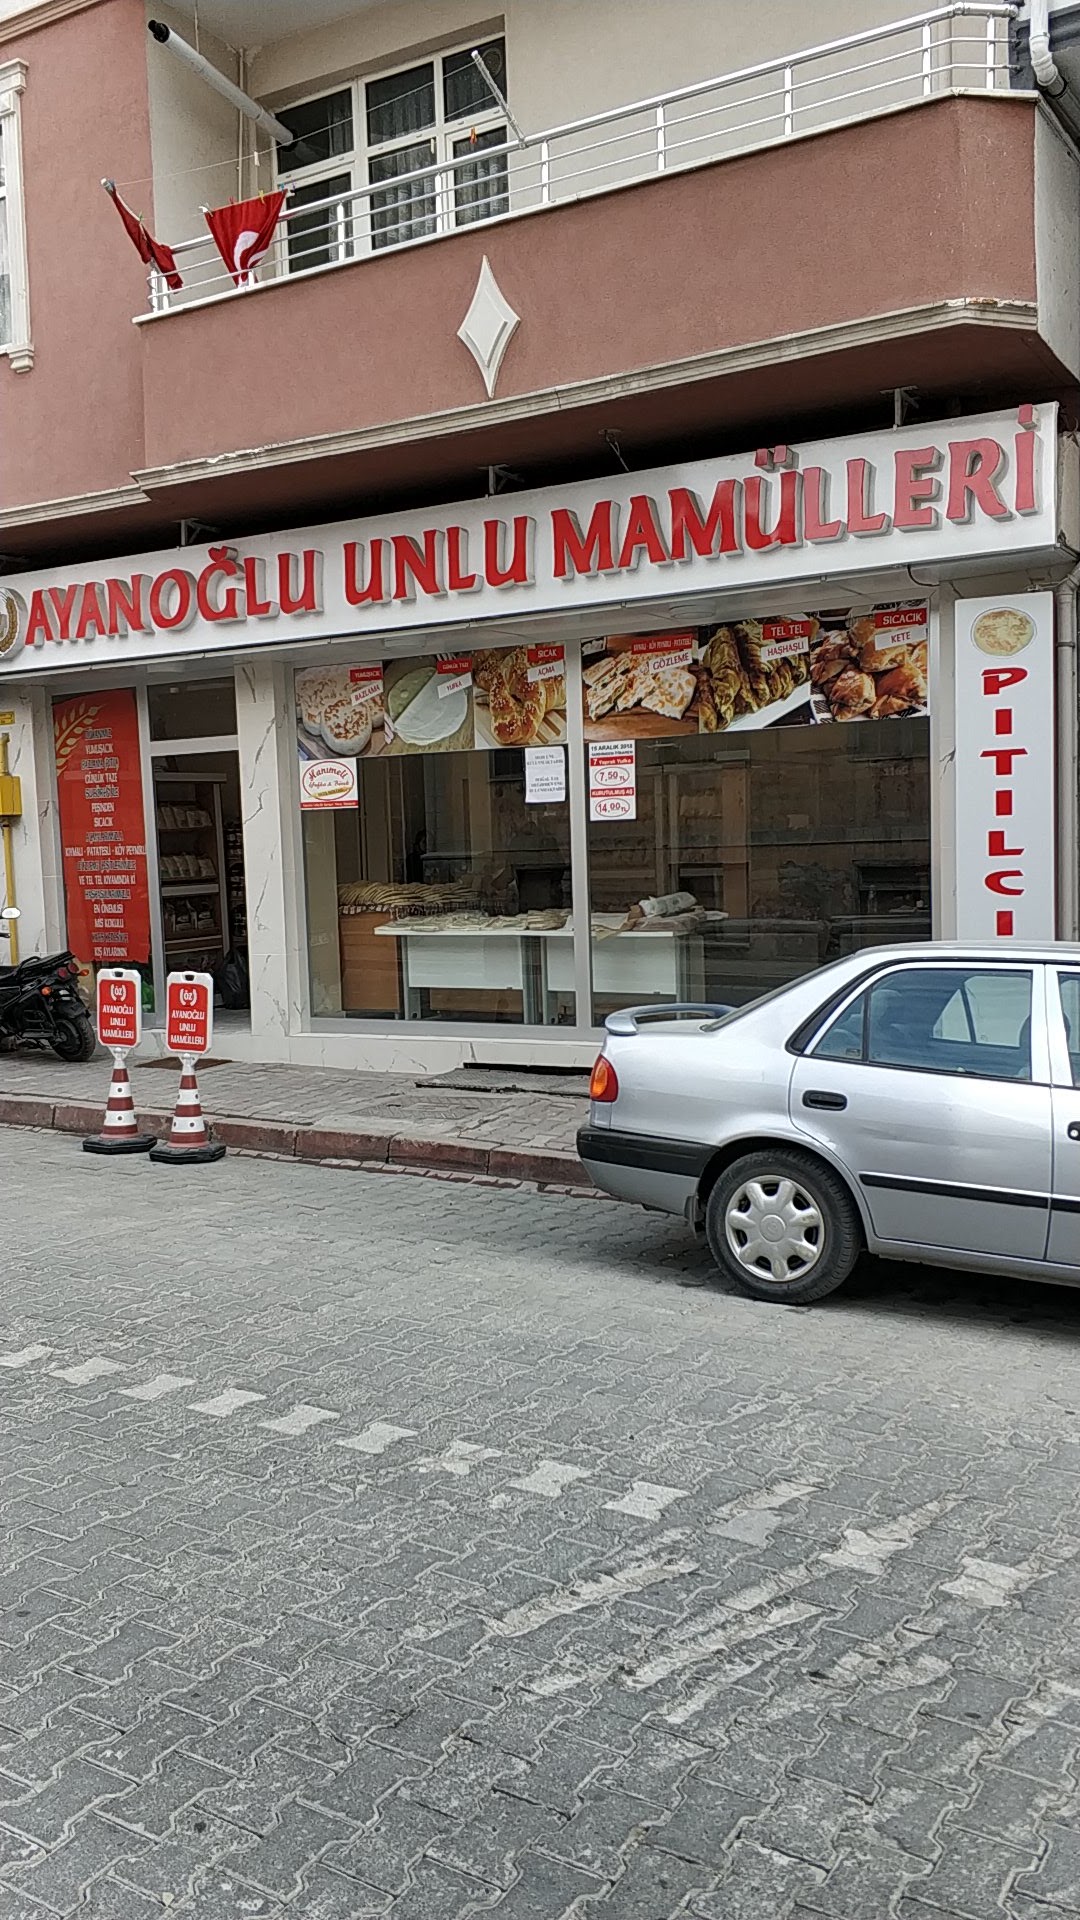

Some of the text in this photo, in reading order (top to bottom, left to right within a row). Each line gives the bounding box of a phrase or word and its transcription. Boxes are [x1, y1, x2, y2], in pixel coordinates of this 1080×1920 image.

[24, 403, 1039, 646] AYANOĞLU UNLU MAMÜLLERİ
[883, 612, 922, 625] SICACIK
[771, 623, 804, 637] TEL TEL
[890, 631, 912, 644] KETE
[537, 649, 557, 658] SICAK
[767, 642, 805, 657] HAŞHAŞLI
[652, 652, 689, 671] GÖZLEME
[537, 665, 556, 676] AÇMA
[102, 1004, 134, 1015] AYANOĞLU
[171, 1009, 205, 1020] AYANOĞLU
[110, 1017, 126, 1026] UNLU
[179, 1023, 196, 1032] UNLU
[102, 1028, 135, 1039] MAMÜLLERİ
[170, 1033, 205, 1045] MAMÜLLERİ
